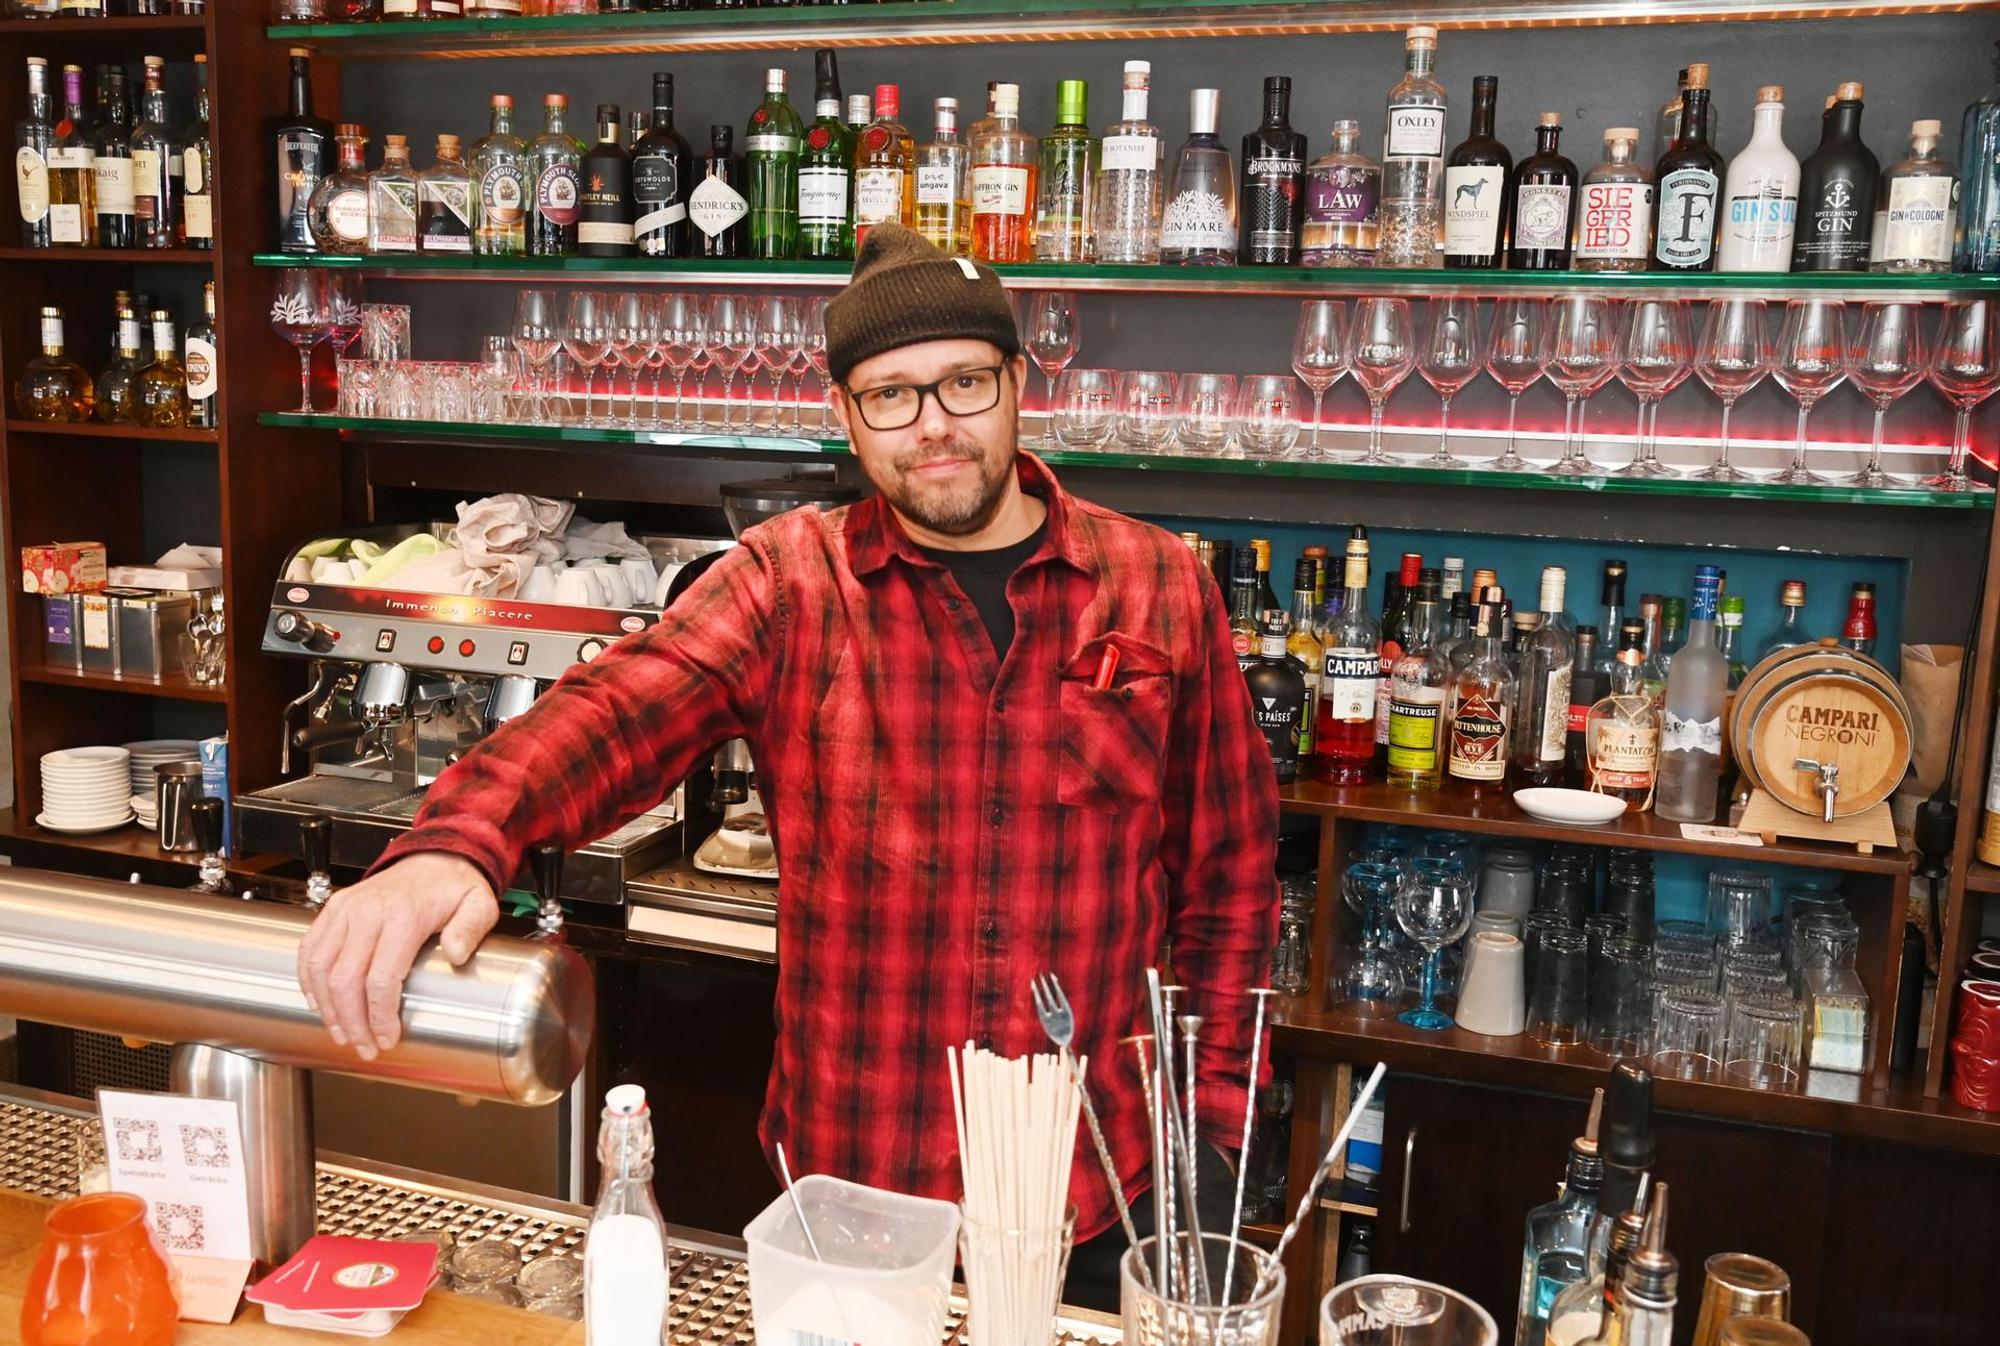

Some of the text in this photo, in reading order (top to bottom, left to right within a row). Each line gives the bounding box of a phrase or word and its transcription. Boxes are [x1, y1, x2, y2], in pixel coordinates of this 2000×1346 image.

[1397, 116, 1436, 127] OXLEY
[285, 142, 319, 155] BEEFEATER
[1247, 159, 1302, 175] BROCKMANS
[484, 167, 522, 196] PLYMOUTH
[540, 167, 566, 203] PLYMOUTH
[919, 182, 949, 191] ungava
[1004, 184, 1019, 192] GIN
[1318, 189, 1363, 209] LAW
[1588, 187, 1633, 209] SIE
[1586, 209, 1632, 227] GFR
[1731, 202, 1764, 223] GIN
[1891, 211, 1904, 221] GIN
[1909, 210, 1945, 221] COLOGNE
[1164, 221, 1225, 233] GIN MARE
[1817, 217, 1854, 232] GIN
[1585, 228, 1631, 248] IED
[473, 606, 533, 621] Piacere
[1327, 658, 1380, 676] CAMPAR
[1785, 704, 1879, 732] CAMPARI
[1784, 724, 1876, 748] NEGRONI
